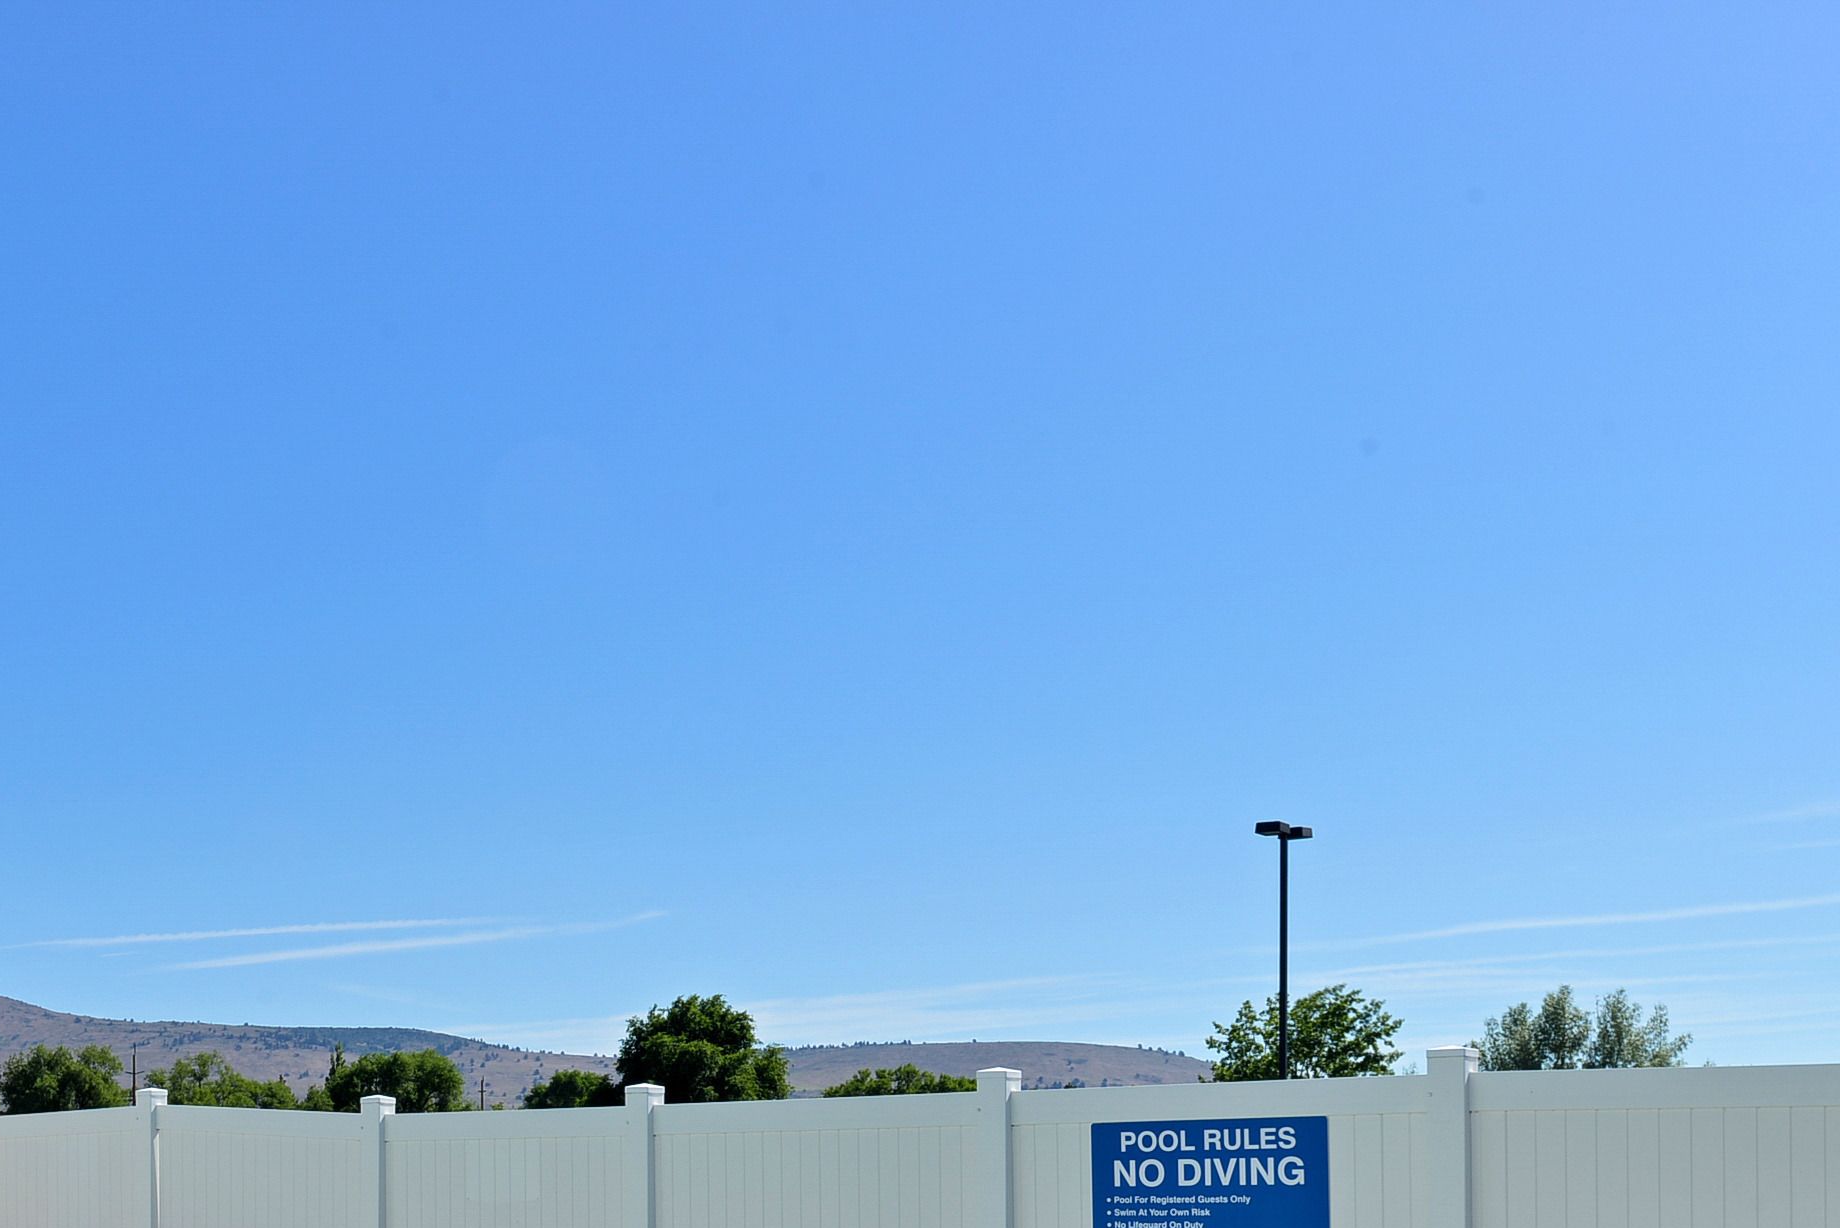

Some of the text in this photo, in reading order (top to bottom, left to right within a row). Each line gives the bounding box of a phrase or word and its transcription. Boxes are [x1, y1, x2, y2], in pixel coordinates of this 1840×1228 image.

[1120, 1127, 1296, 1152] POOL RULES
[1113, 1156, 1305, 1187] NO DIVING
[1114, 1196, 1133, 1204] Pool
[1150, 1196, 1196, 1205] Registered
[1197, 1195, 1228, 1203] Guests
[1230, 1195, 1251, 1205] Only
[1114, 1208, 1210, 1216] Swim At Your Own Risk
[1114, 1221, 1126, 1228] No
[1169, 1221, 1181, 1228] On
